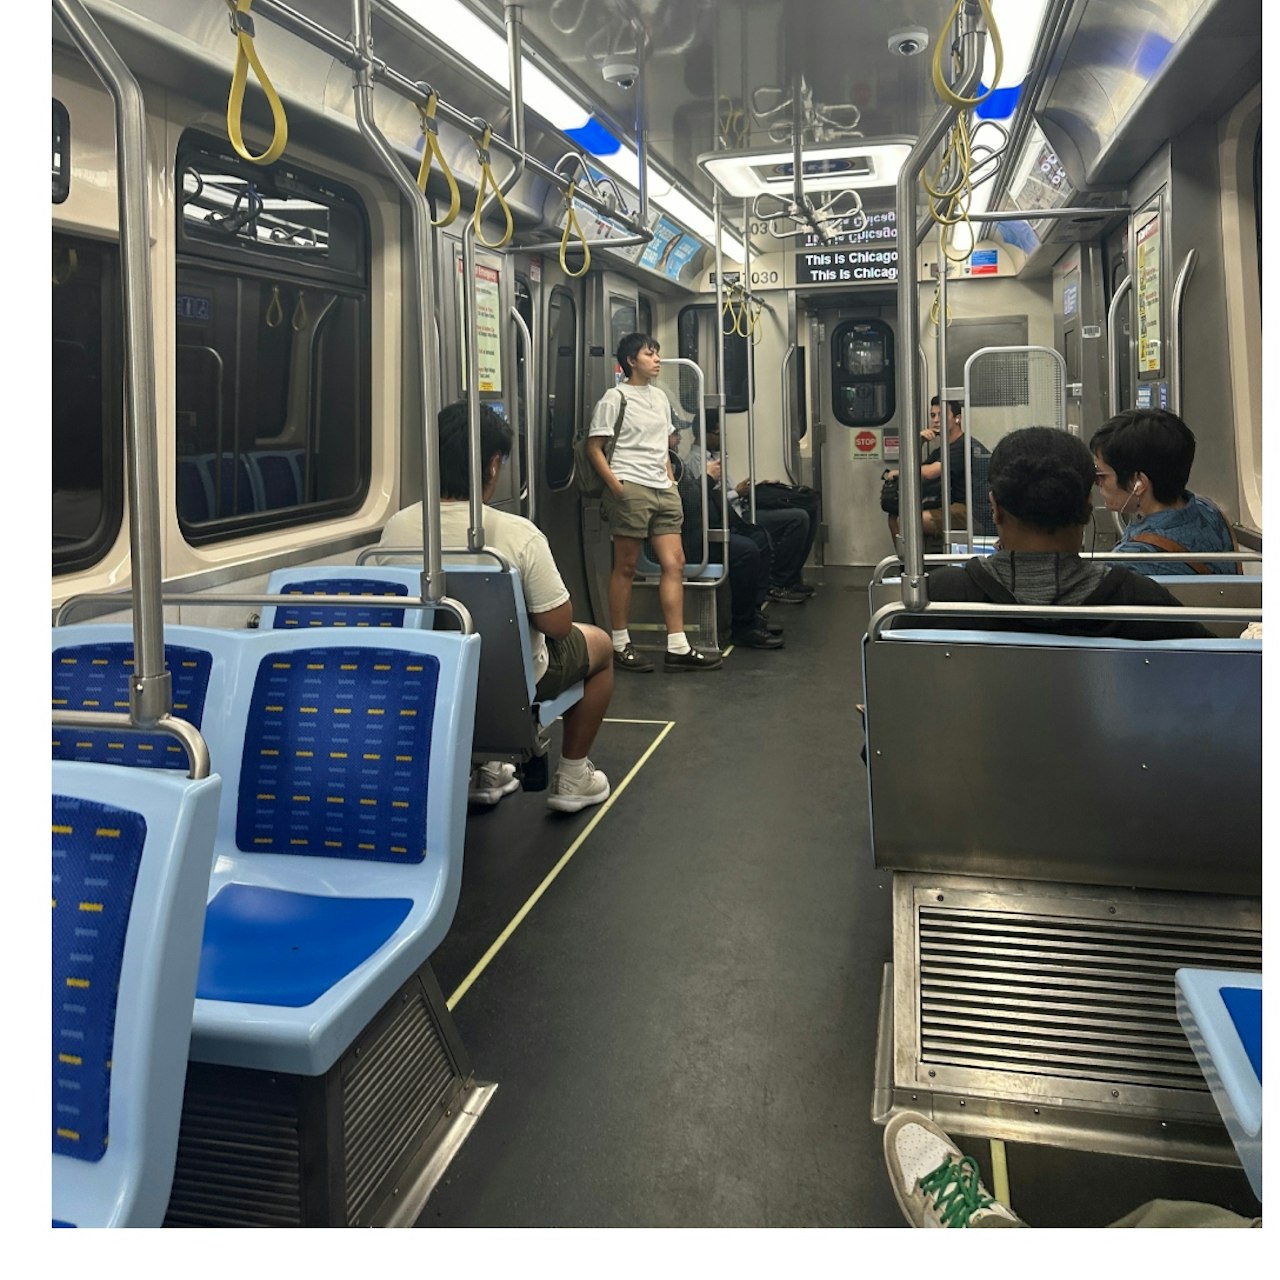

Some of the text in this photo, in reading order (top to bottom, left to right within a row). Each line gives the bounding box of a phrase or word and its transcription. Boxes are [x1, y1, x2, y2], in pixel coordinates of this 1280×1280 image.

[805, 251, 898, 267] This is Chicago
[811, 266, 898, 282] This is Chicag
[856, 438, 876, 446] STOP
